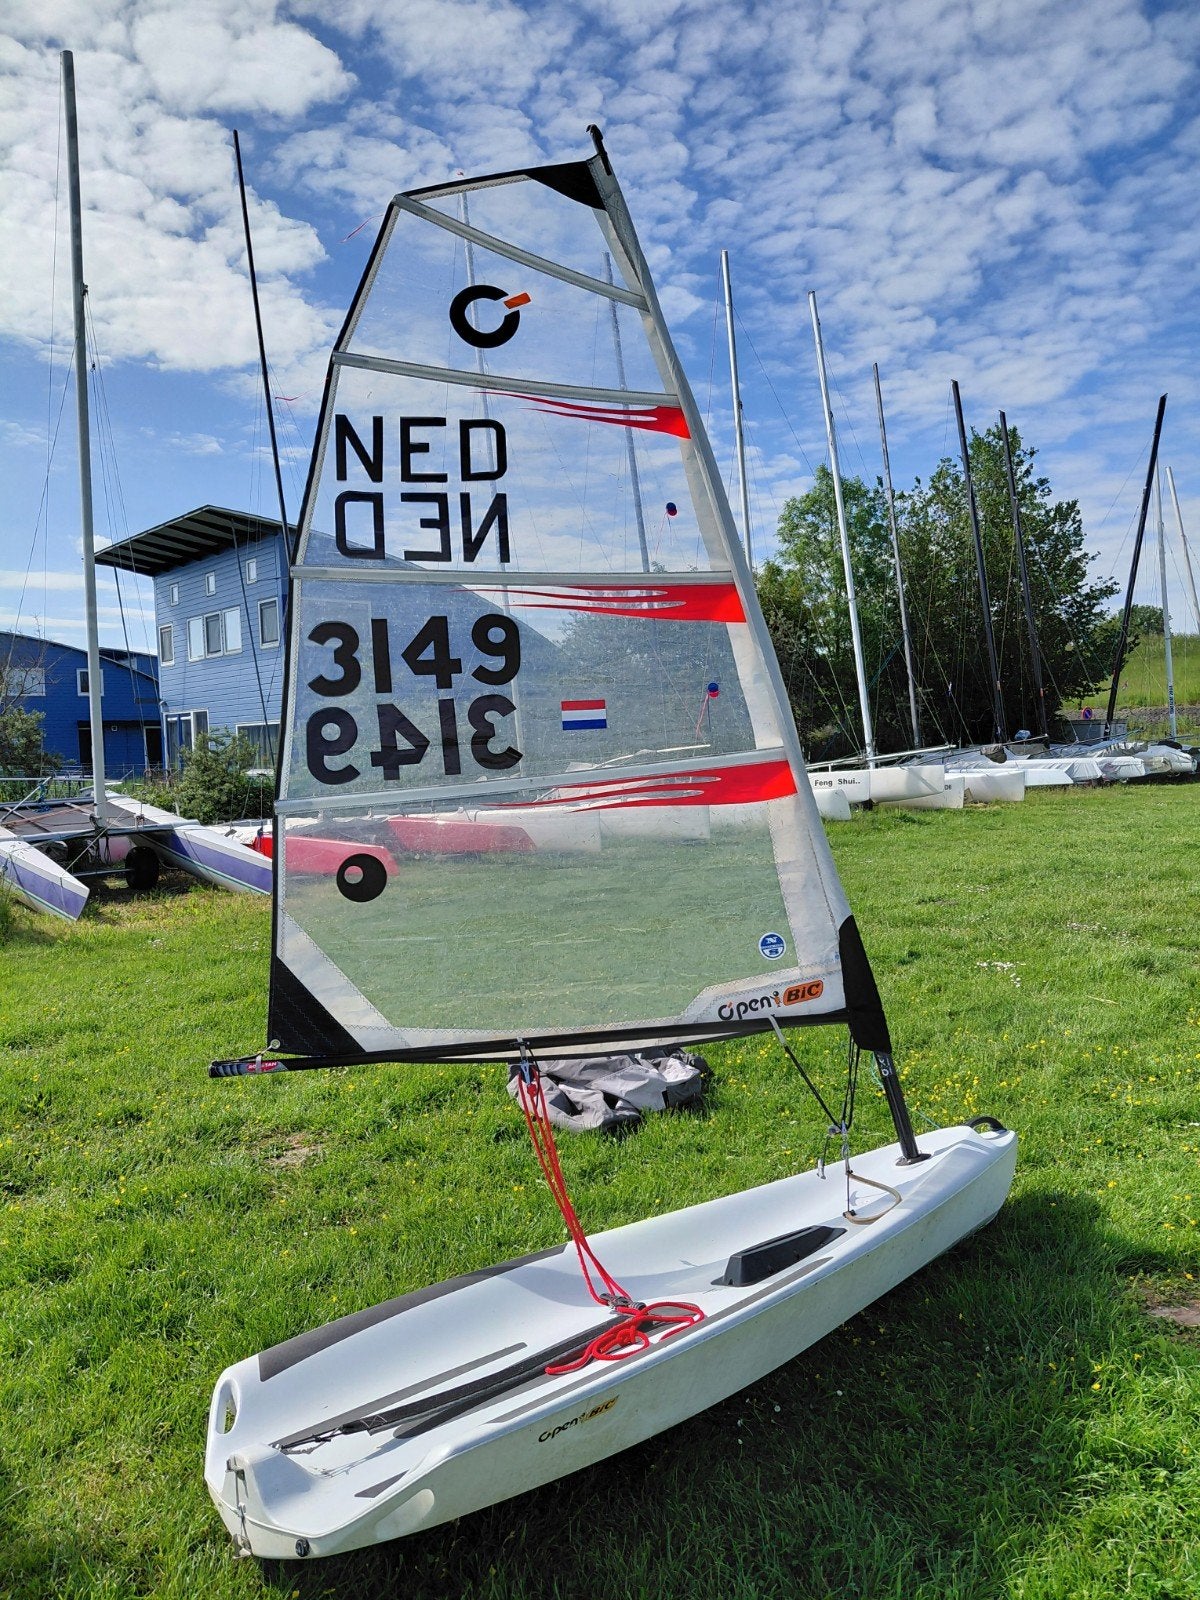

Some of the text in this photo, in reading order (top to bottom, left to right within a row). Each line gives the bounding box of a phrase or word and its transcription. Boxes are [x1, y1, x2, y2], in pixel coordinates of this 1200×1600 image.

[335, 414, 507, 483] NED
[307, 614, 521, 697] 3149
[814, 779, 833, 787] Feng
